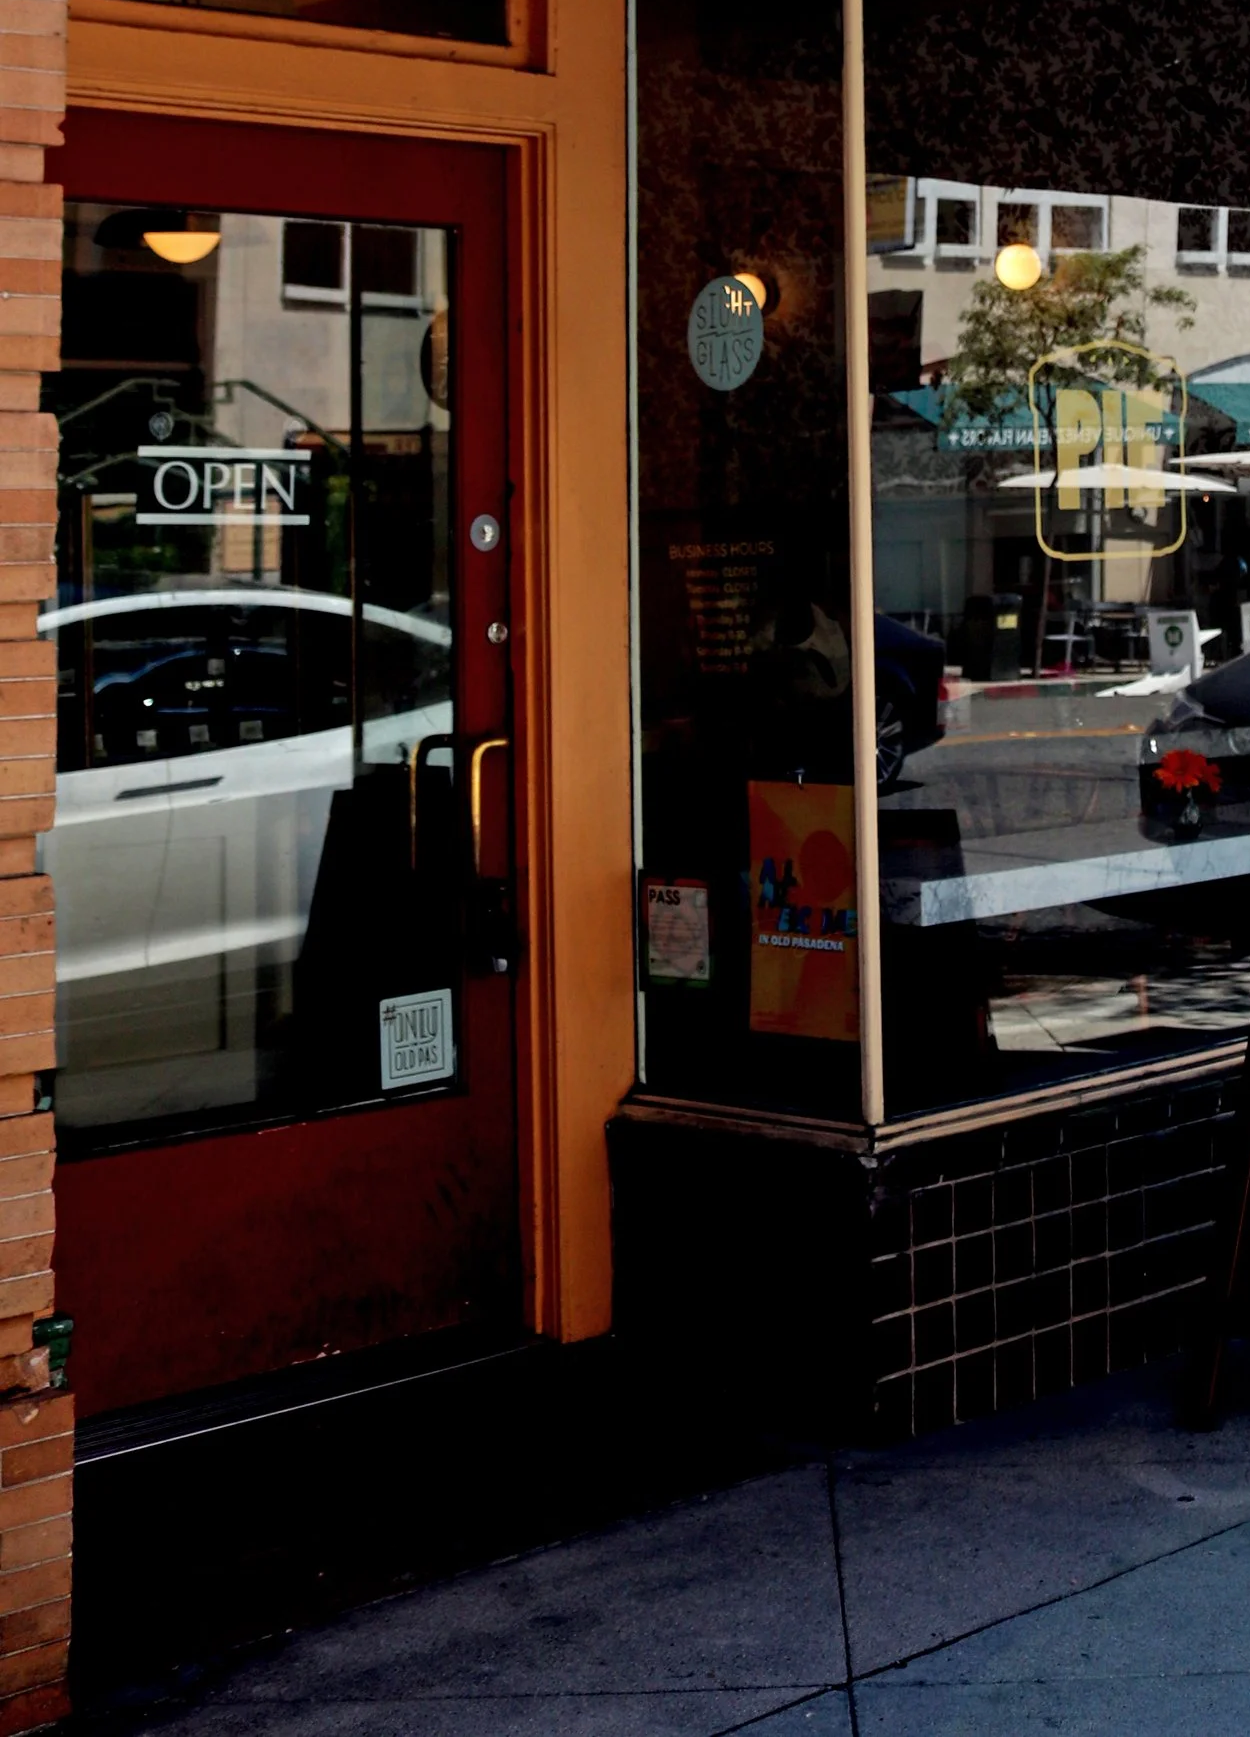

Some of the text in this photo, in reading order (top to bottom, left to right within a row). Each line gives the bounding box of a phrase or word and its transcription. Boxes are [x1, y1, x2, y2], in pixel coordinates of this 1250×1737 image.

[696, 337, 755, 382] GLASS
[1056, 389, 1166, 510] PIE
[153, 461, 295, 510] OPEN
[668, 542, 728, 560] BUSINESS
[649, 889, 681, 906] PASS
[771, 935, 790, 948] OLD
[792, 936, 844, 952] PASADENA
[394, 1044, 438, 1071] OLD PAS
